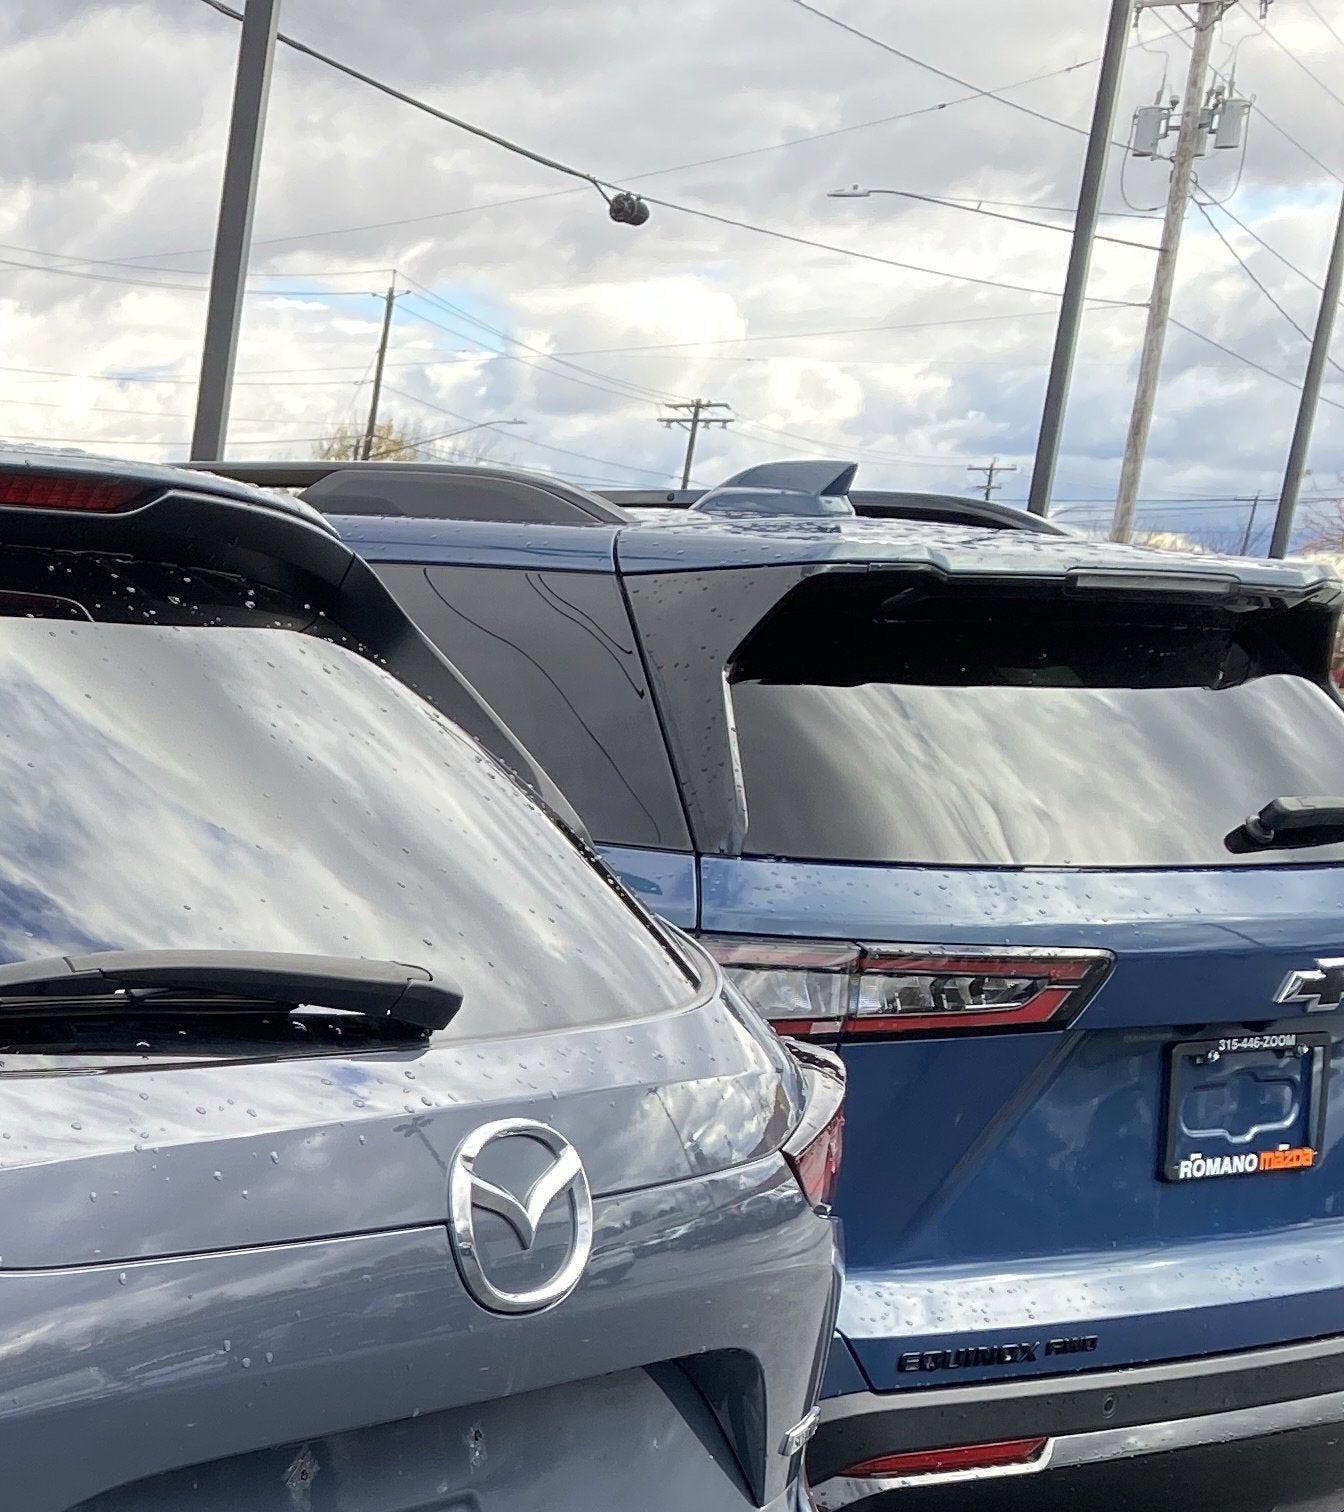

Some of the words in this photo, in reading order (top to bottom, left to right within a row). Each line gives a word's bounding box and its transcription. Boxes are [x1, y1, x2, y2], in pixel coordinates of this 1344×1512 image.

[1218, 1034, 1296, 1051] 315-446-ZOOM
[1179, 1153, 1258, 1179] ROMANO
[897, 1341, 1041, 1372] EQUINOX
[1043, 1334, 1099, 1356] AWD
